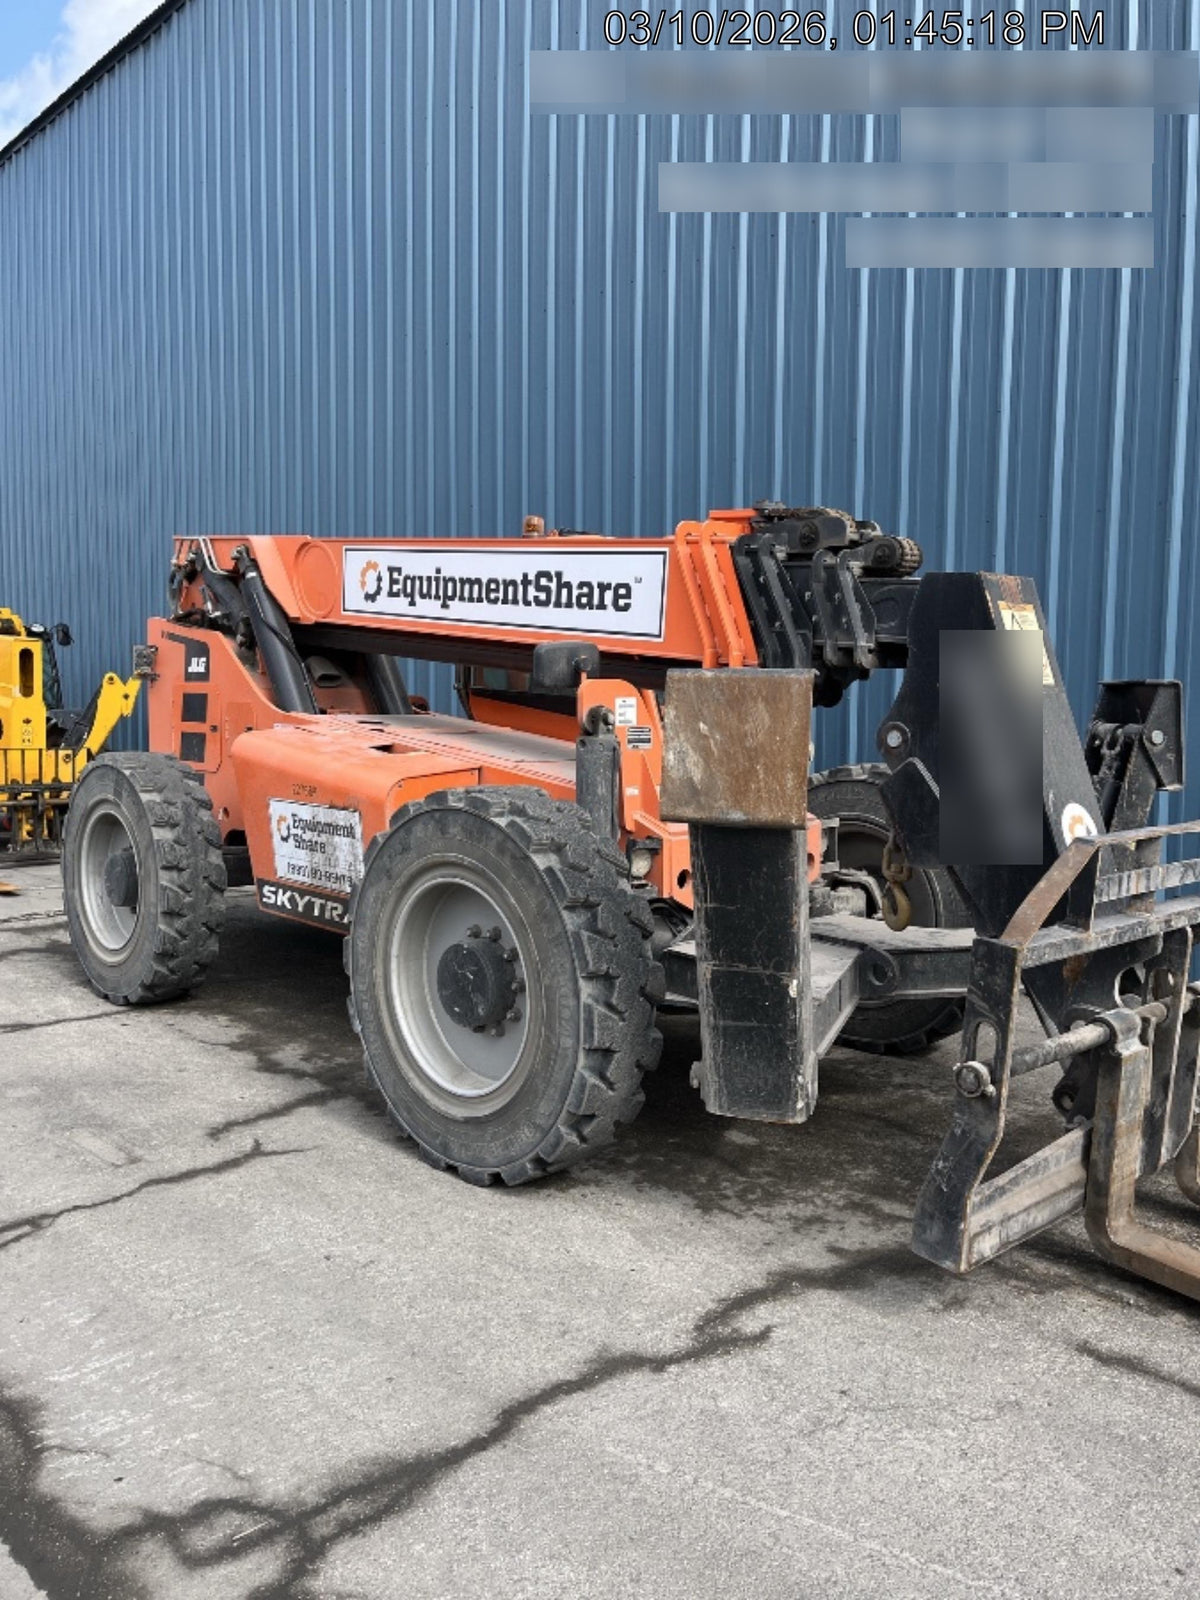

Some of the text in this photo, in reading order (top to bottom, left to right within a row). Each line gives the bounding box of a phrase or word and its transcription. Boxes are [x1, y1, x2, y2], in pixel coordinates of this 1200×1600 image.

[387, 566, 632, 612] EquipmentShare
[188, 657, 207, 672] JLG
[291, 813, 357, 840] Equipment
[293, 833, 326, 854] Share
